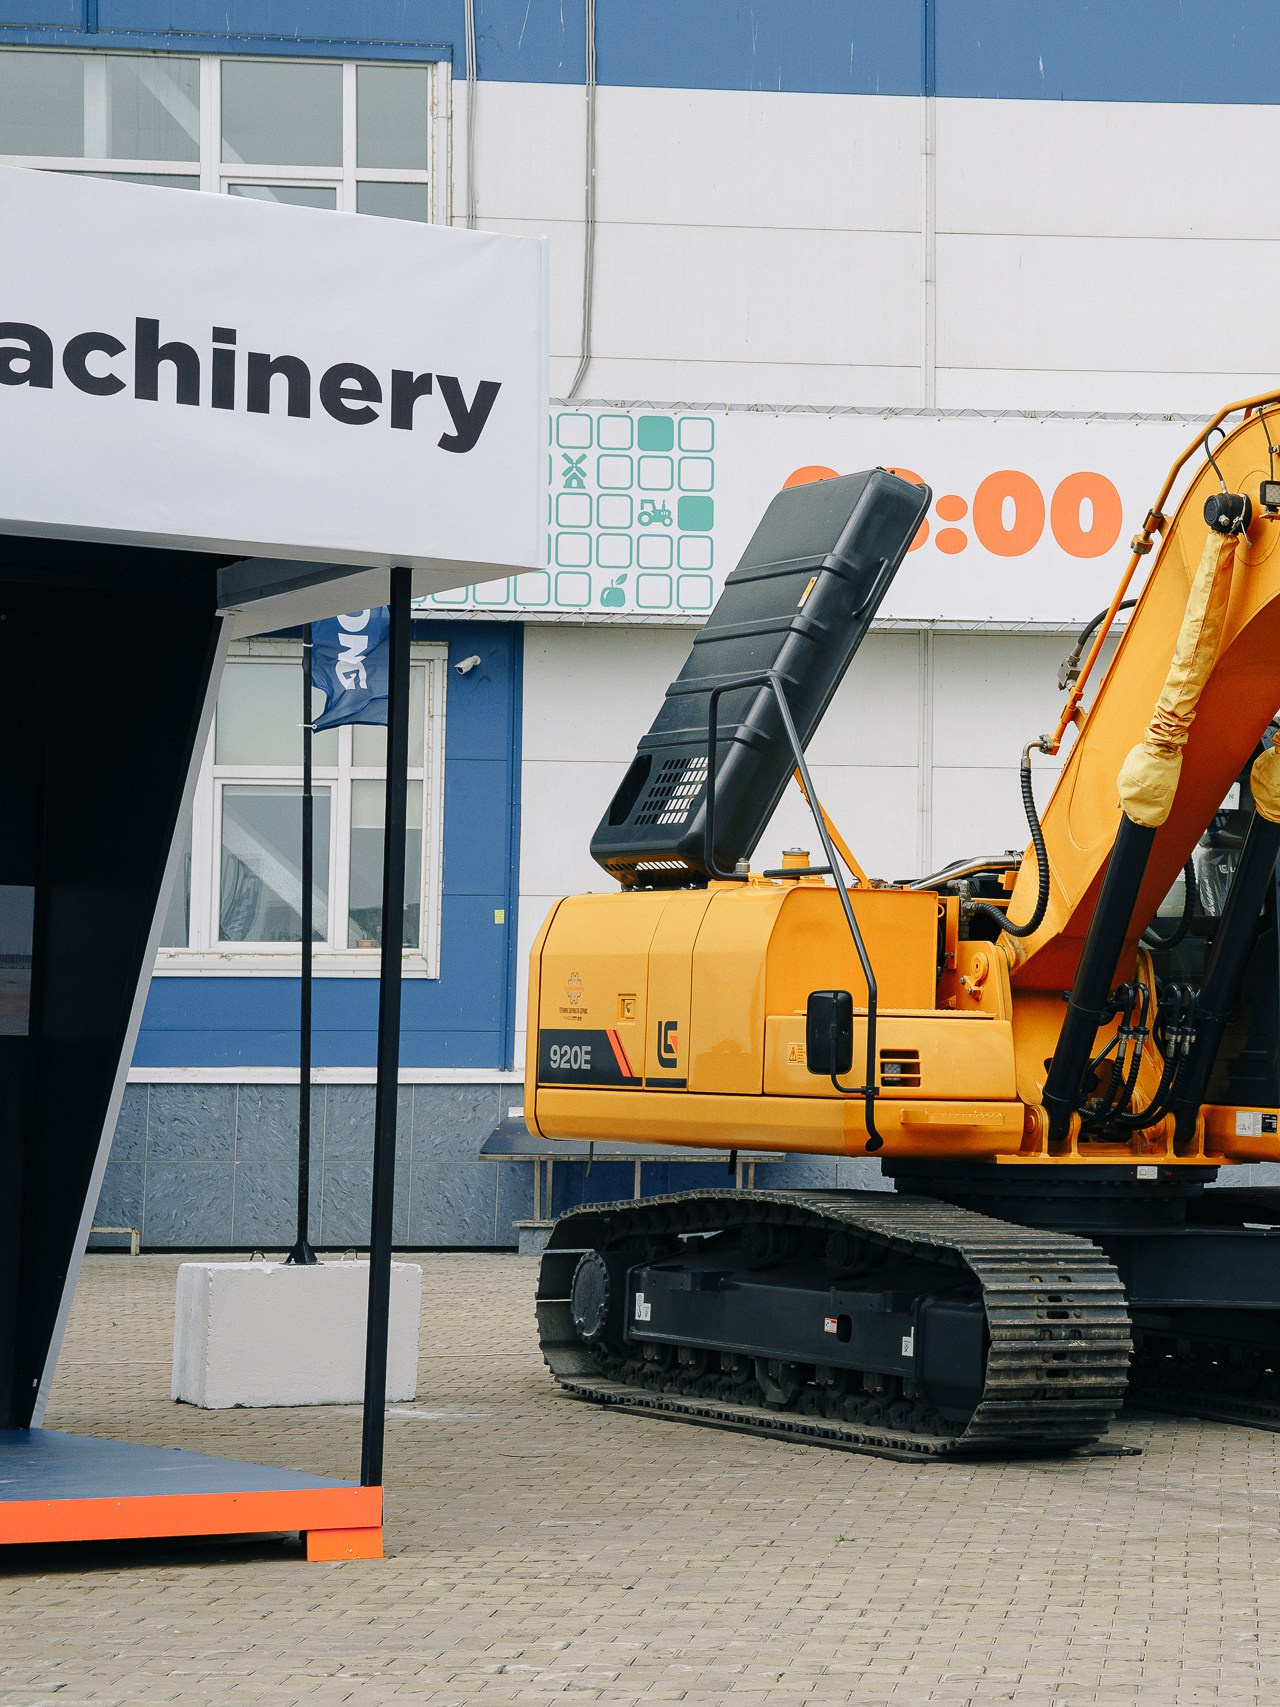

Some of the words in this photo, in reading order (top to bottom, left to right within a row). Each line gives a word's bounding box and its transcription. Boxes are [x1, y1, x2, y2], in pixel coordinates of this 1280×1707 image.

[0, 316, 502, 454] achinery
[782, 466, 1123, 559] :00
[549, 1044, 592, 1070] 920E
